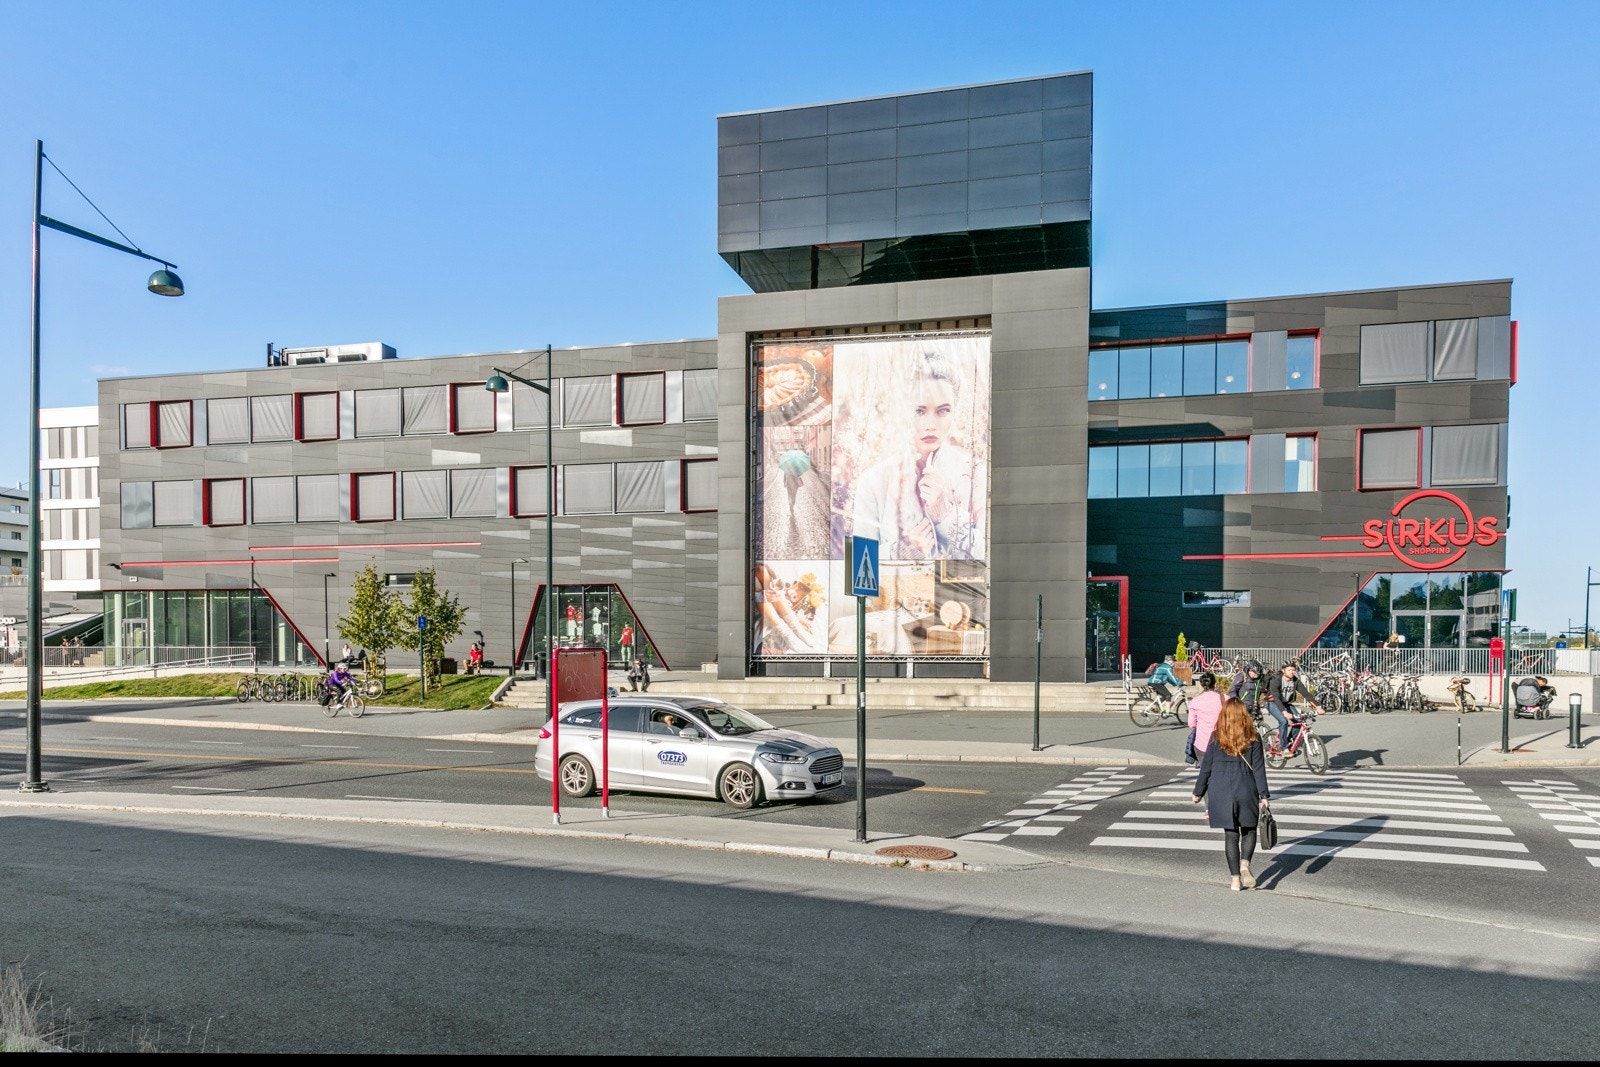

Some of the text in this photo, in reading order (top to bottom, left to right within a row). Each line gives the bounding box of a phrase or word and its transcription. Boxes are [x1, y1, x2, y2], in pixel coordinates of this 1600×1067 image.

[1363, 517, 1498, 548] SIRKUS
[1408, 547, 1450, 555] SHOPPING
[660, 753, 684, 763] 07373
